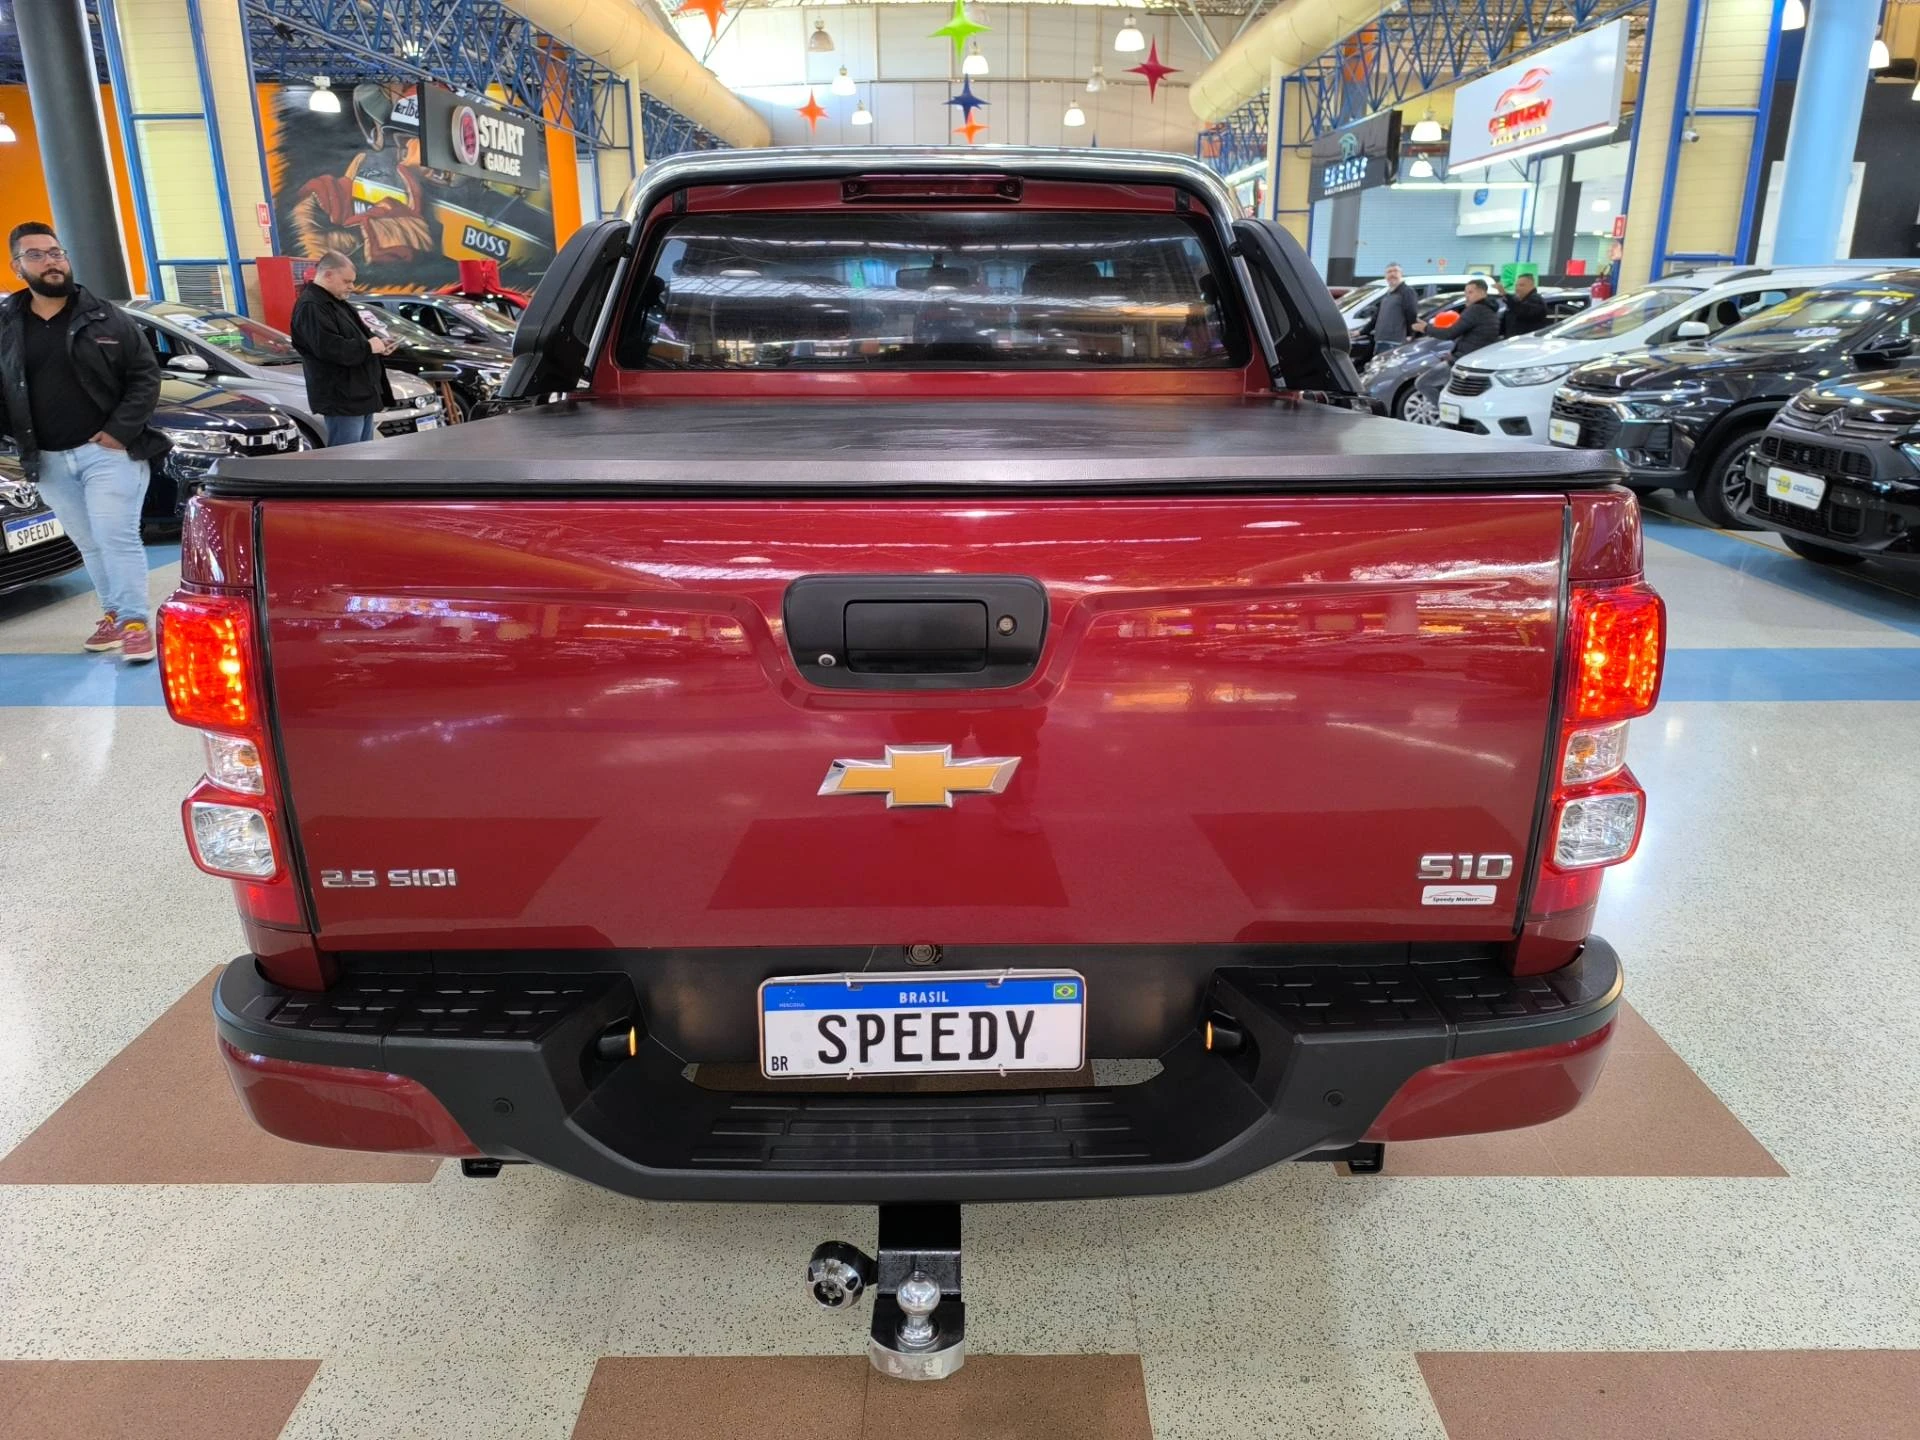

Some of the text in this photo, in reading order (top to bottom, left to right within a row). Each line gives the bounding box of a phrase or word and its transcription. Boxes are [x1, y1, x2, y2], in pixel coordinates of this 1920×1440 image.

[478, 114, 525, 156] START
[485, 152, 522, 177] GARAGE
[464, 226, 508, 258] BOSS
[16, 521, 56, 546] SPEEDY
[1417, 852, 1513, 880] S10
[1432, 896, 1455, 904] Speedy
[899, 990, 950, 1004] BRASIL
[817, 1009, 1036, 1065] SPEEDY
[770, 1055, 789, 1072] BR
